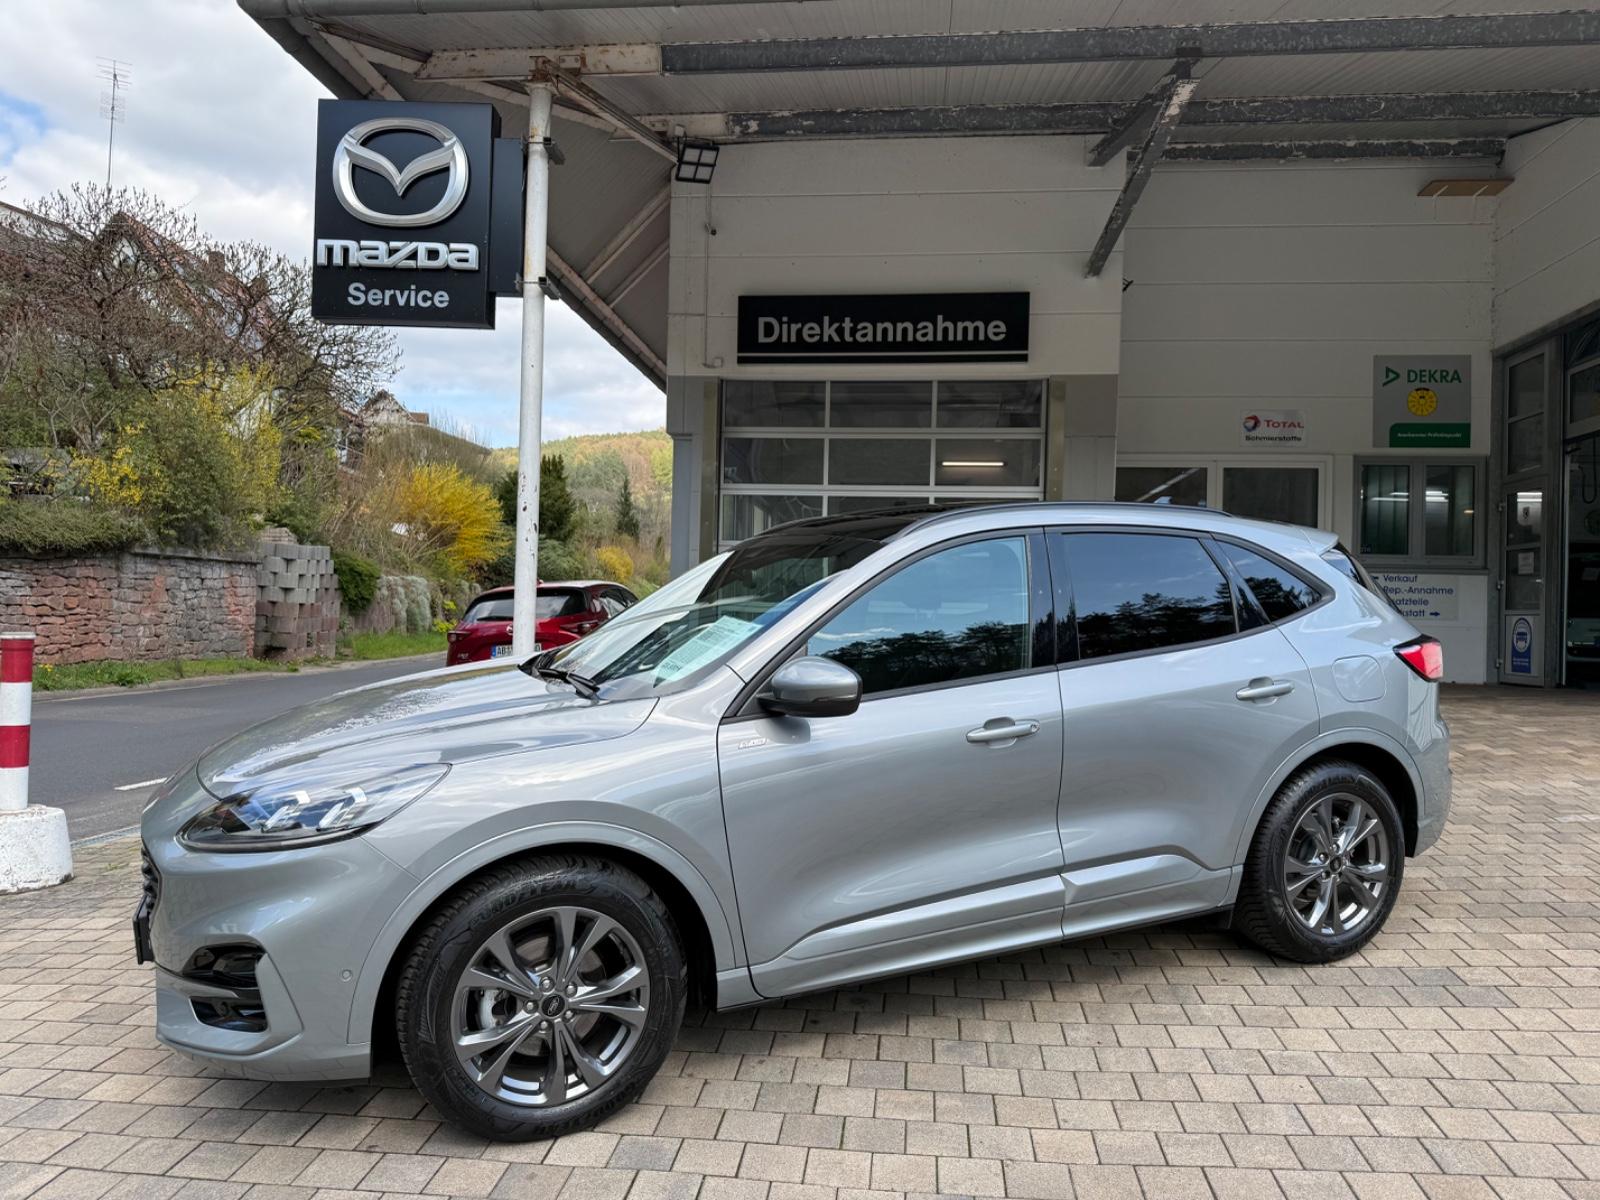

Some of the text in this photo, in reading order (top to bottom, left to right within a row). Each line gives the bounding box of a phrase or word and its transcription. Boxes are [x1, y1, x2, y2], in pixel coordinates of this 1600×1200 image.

[316, 238, 480, 271] mazda
[347, 282, 450, 308] Service
[757, 314, 1008, 343] Direktannahme
[1407, 369, 1462, 383] DEKRA
[1264, 419, 1304, 429] TOTAL
[1383, 574, 1418, 583] Verkauf
[1383, 586, 1454, 595] Rep.-Annahme
